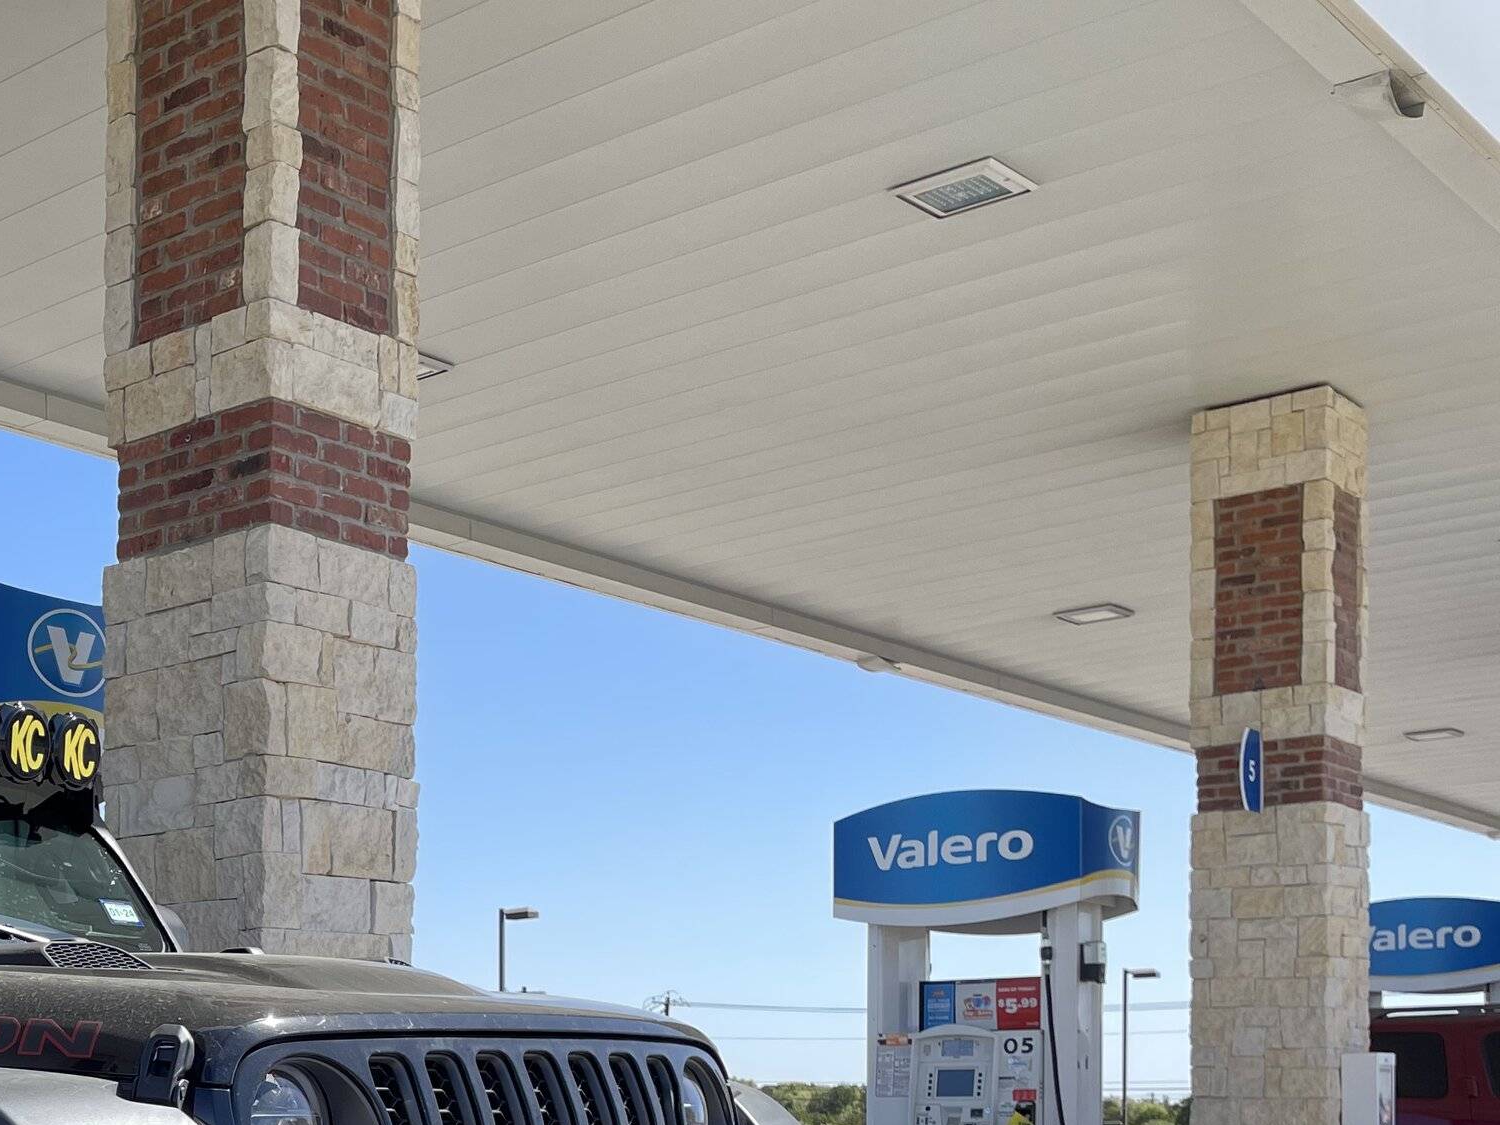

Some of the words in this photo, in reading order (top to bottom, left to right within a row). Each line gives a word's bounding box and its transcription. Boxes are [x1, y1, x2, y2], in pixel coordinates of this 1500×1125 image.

[11, 715, 45, 772] KC
[63, 723, 96, 780] KC
[1248, 759, 1256, 782] 5
[867, 829, 1035, 871] Valero
[1004, 1037, 1033, 1054] 05
